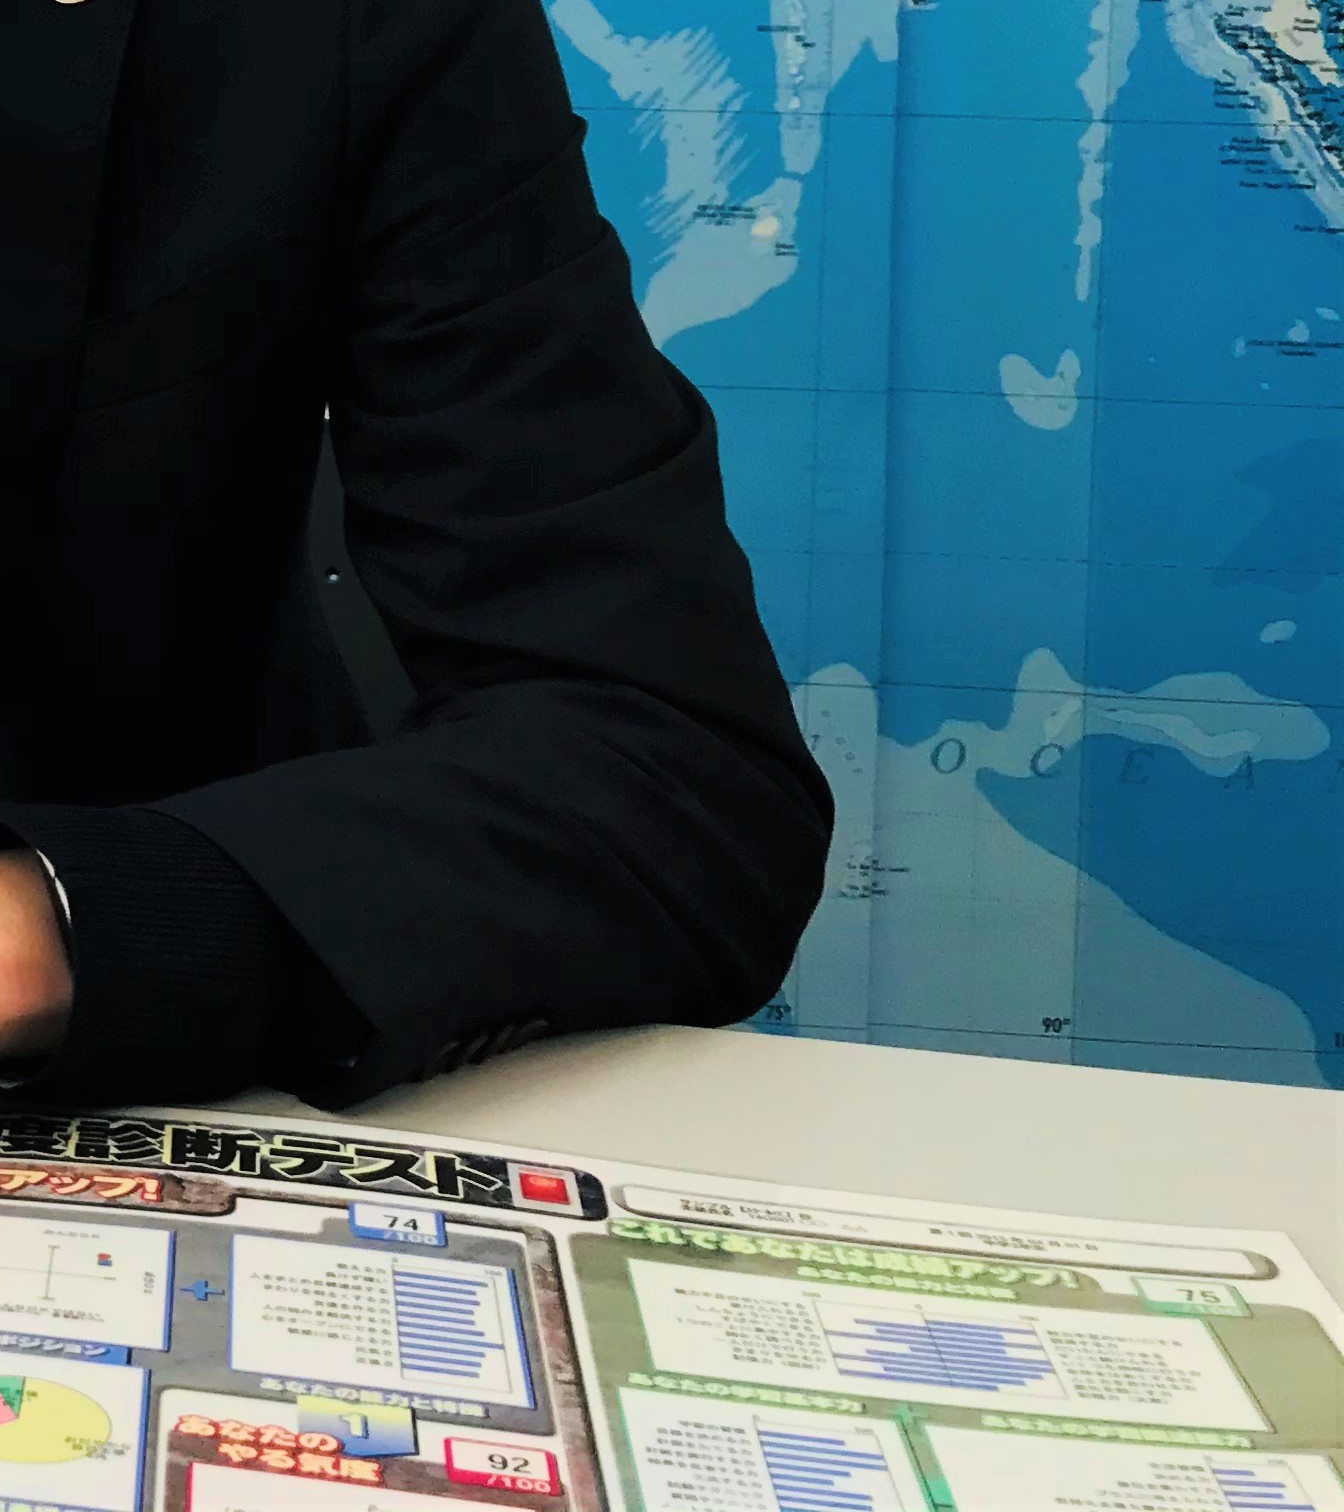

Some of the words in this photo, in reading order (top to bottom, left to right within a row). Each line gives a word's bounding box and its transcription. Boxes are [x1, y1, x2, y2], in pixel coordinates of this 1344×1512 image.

[1042, 1016, 1071, 1034] 90°
[383, 1214, 419, 1232] 74
[1176, 1287, 1223, 1305] 75
[174, 1414, 343, 1453] あなたの
[217, 1440, 384, 1483] やる気度
[487, 1453, 532, 1475] 92
